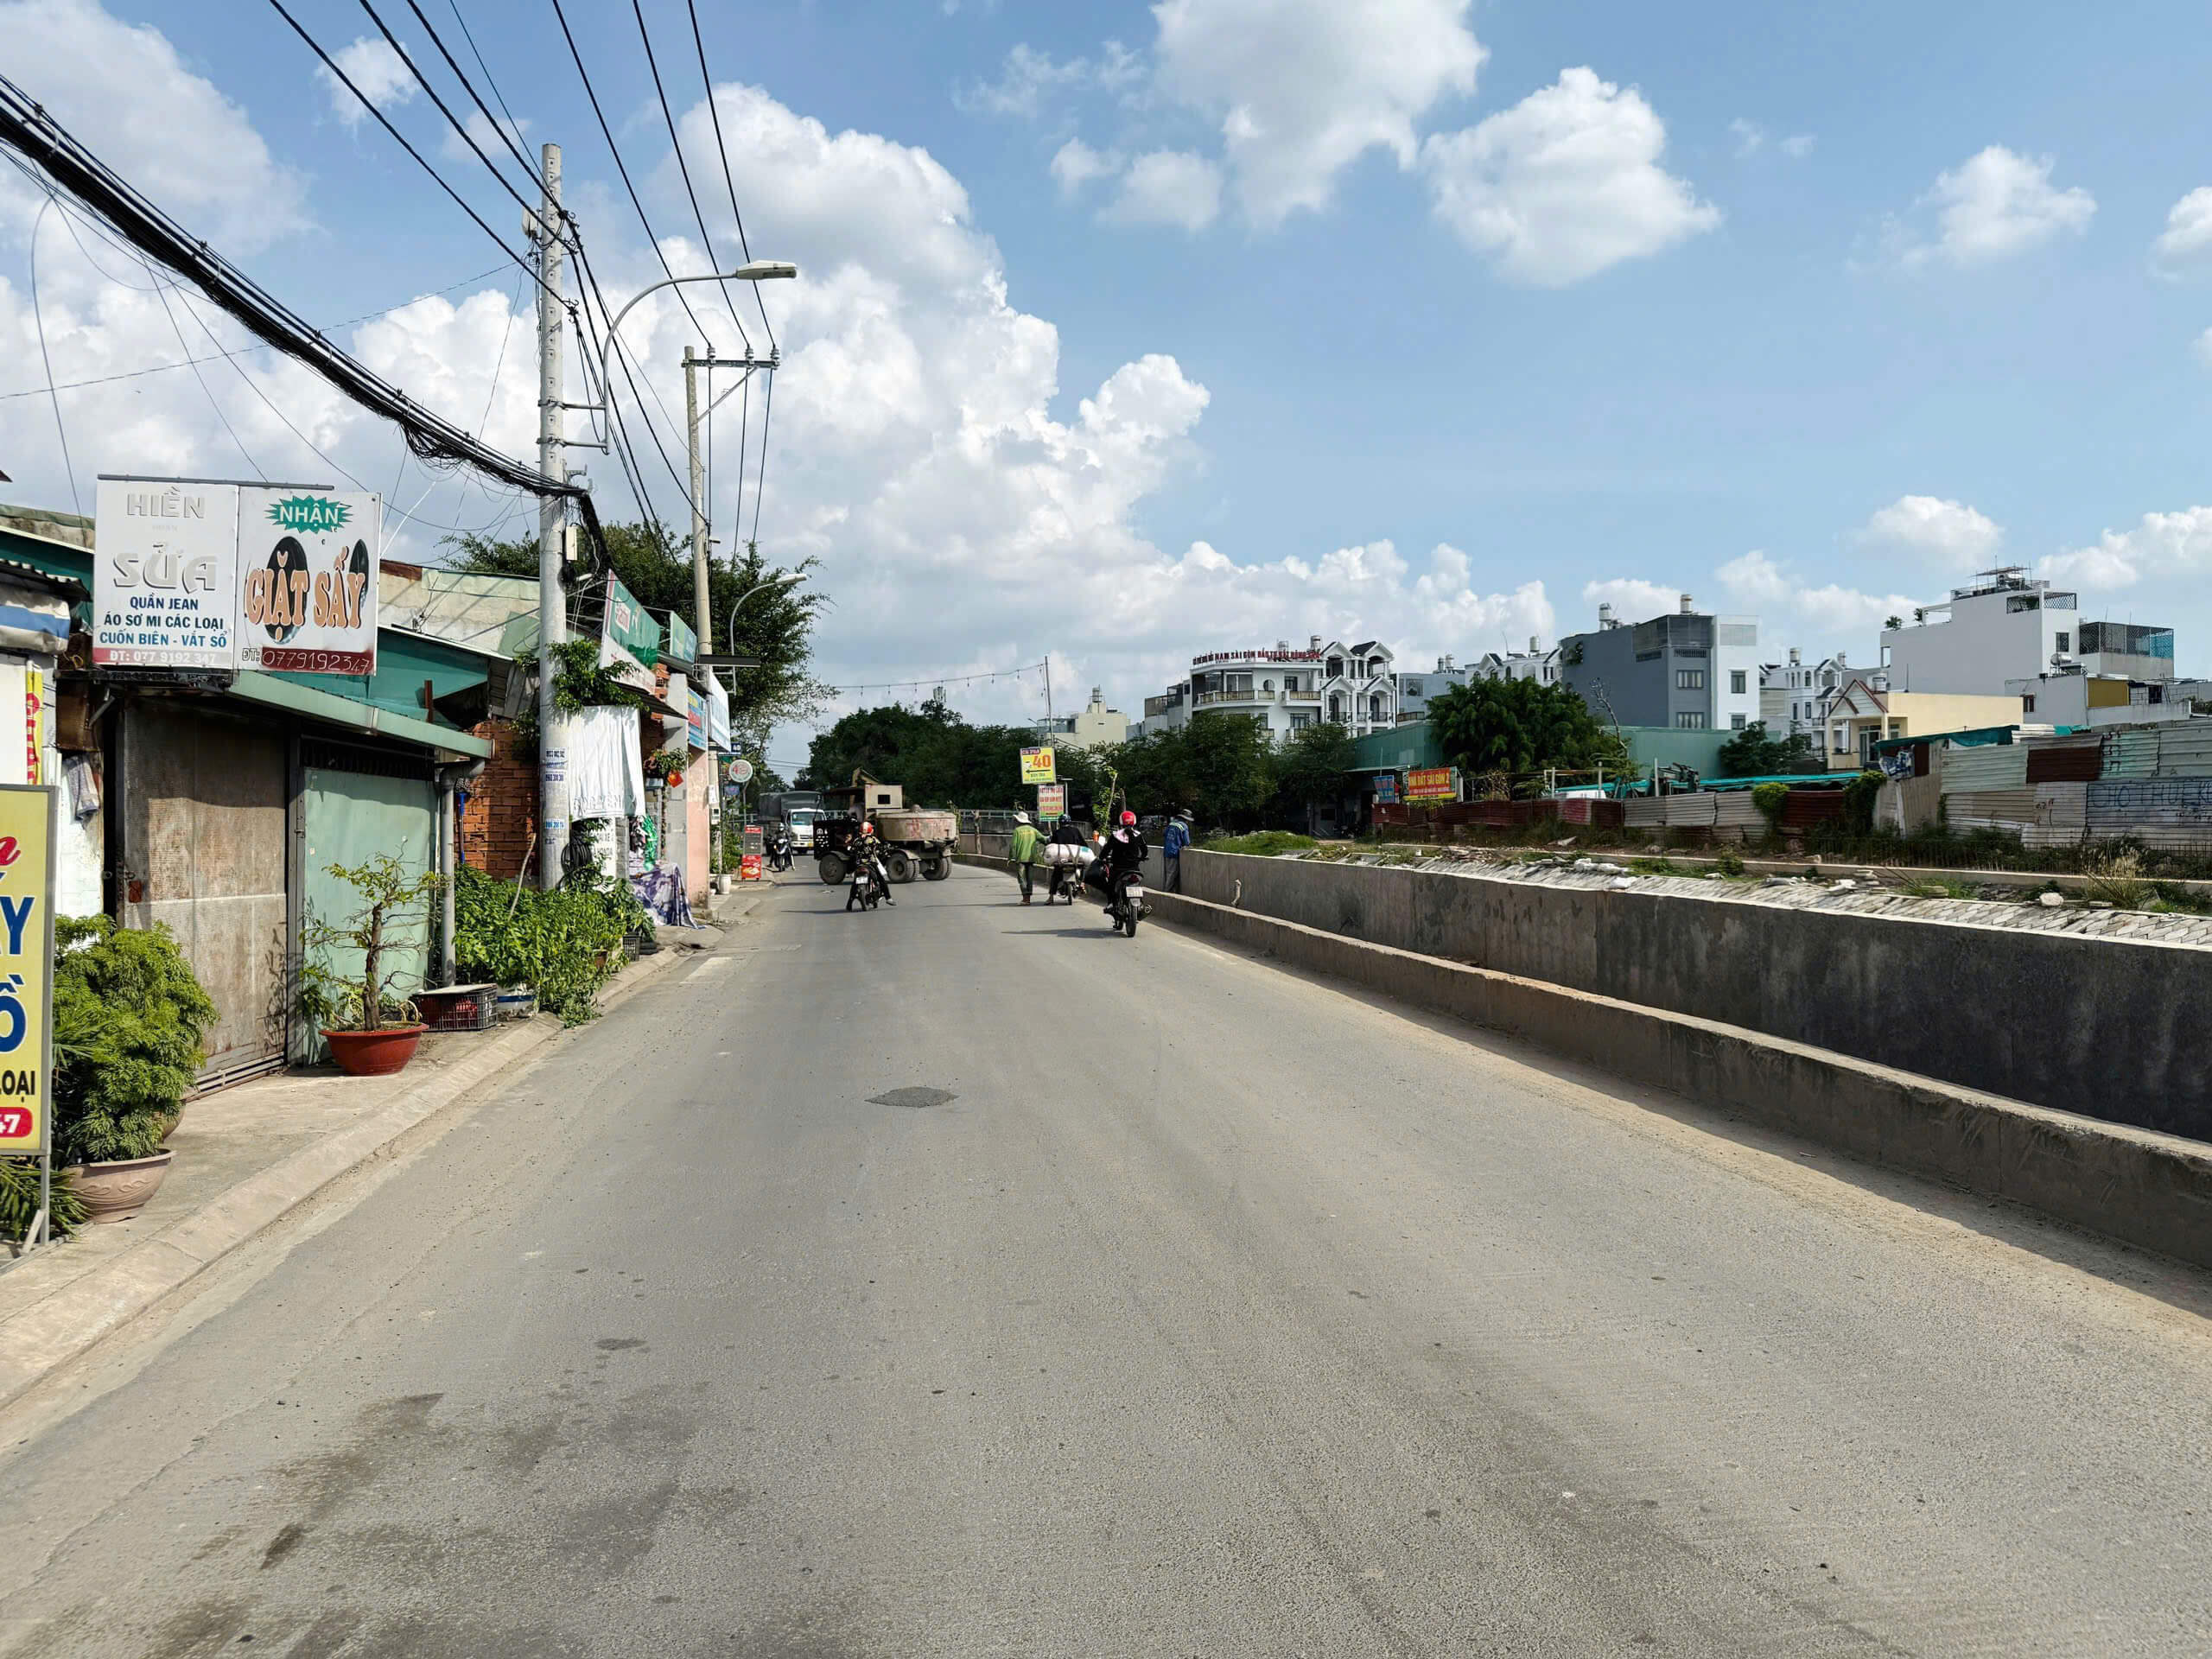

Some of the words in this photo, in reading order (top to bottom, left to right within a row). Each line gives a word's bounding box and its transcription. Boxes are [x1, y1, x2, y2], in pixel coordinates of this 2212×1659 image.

[127, 486, 206, 518] HIỀN
[279, 504, 339, 527] NHẬN
[130, 593, 164, 610] QUẦN
[168, 598, 198, 610] JEAN
[245, 550, 310, 642] GIẶT
[313, 545, 366, 630] SẤY
[104, 611, 122, 626] ÁO
[125, 613, 143, 626] SƠ
[146, 615, 161, 627] MI
[165, 613, 191, 629] CÁC
[194, 617, 224, 632] LOẠI
[99, 628, 134, 645] CUỐN
[138, 631, 168, 645] BIÊN
[210, 631, 228, 648] SỔ
[110, 650, 130, 661] ĐT:
[133, 651, 157, 663] 077
[160, 652, 191, 664] 9192
[196, 653, 217, 664] 347
[262, 650, 370, 673] 0779192347
[0, 872, 35, 956] Y
[0, 974, 27, 1053] Ồ
[0, 1070, 36, 1103] OẠI
